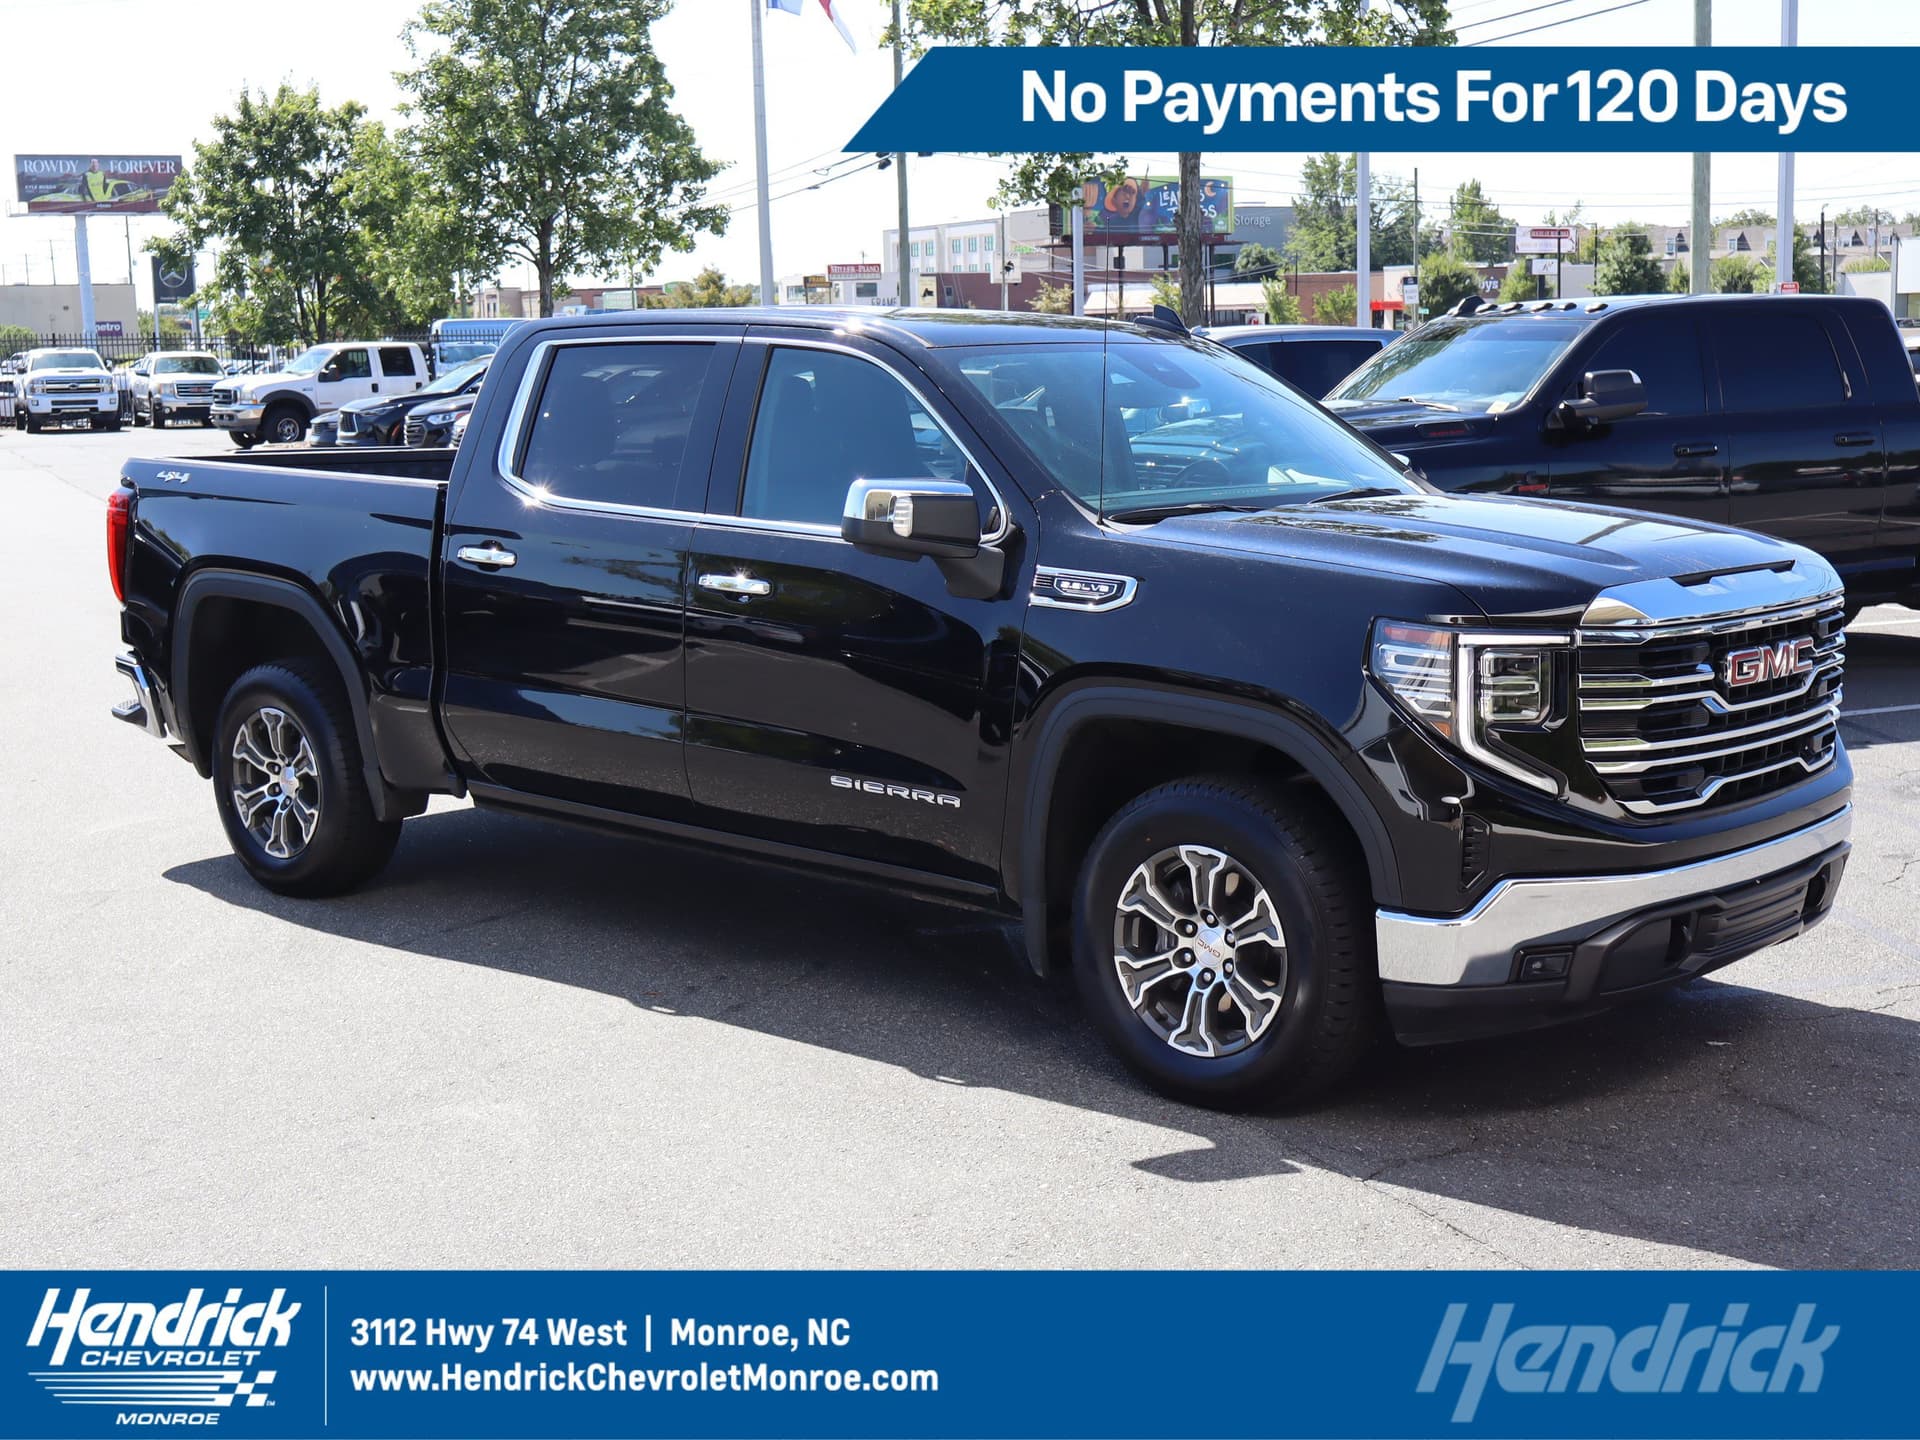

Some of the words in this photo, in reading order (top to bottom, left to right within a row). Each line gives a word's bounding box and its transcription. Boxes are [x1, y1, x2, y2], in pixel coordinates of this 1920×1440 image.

[23, 159, 79, 173] ROWDY
[109, 159, 176, 174] FOREVER
[1234, 214, 1272, 227] Storage
[1726, 636, 1814, 688] GMC
[830, 775, 961, 808] SIERRA
[1197, 938, 1221, 958] GMC
